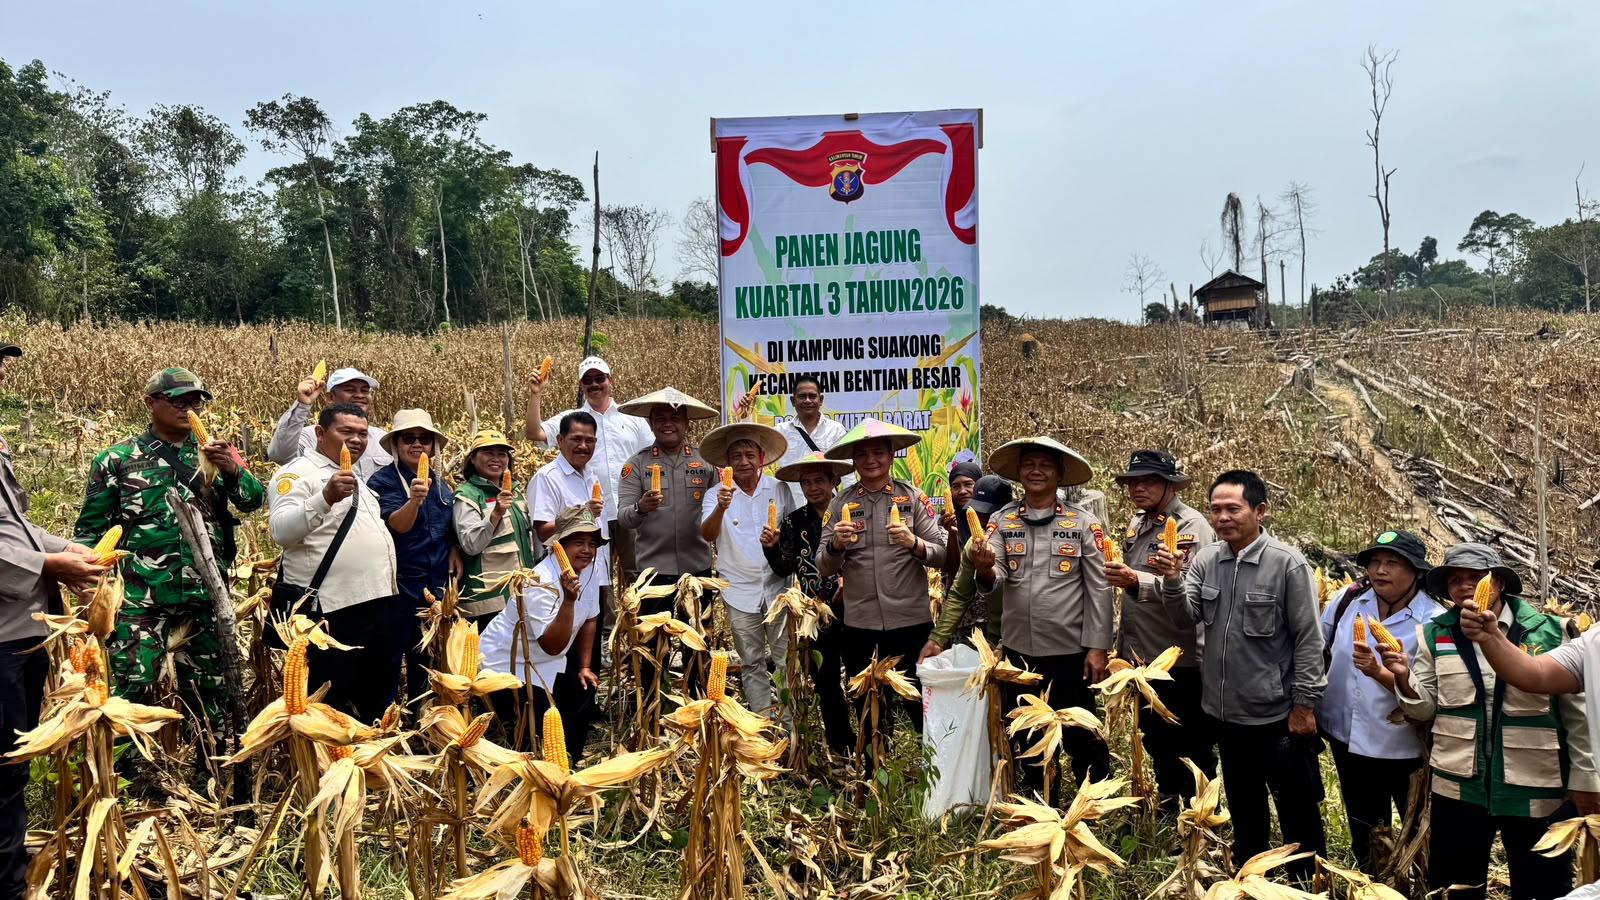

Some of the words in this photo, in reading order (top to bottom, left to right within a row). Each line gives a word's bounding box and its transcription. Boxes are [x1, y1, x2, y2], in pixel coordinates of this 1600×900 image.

[776, 233, 839, 268] PANEN
[844, 229, 921, 264] JAGUNG
[735, 283, 823, 319] KUARTAL
[827, 281, 841, 315] 3
[767, 341, 784, 362] DI
[787, 337, 864, 362] KAMPUNG
[868, 334, 941, 358] SUAKONG
[843, 368, 908, 392] BENTIAN
[912, 366, 961, 389] BESAR
[882, 410, 932, 431] BARAT
[1053, 531, 1080, 539] POLRI
